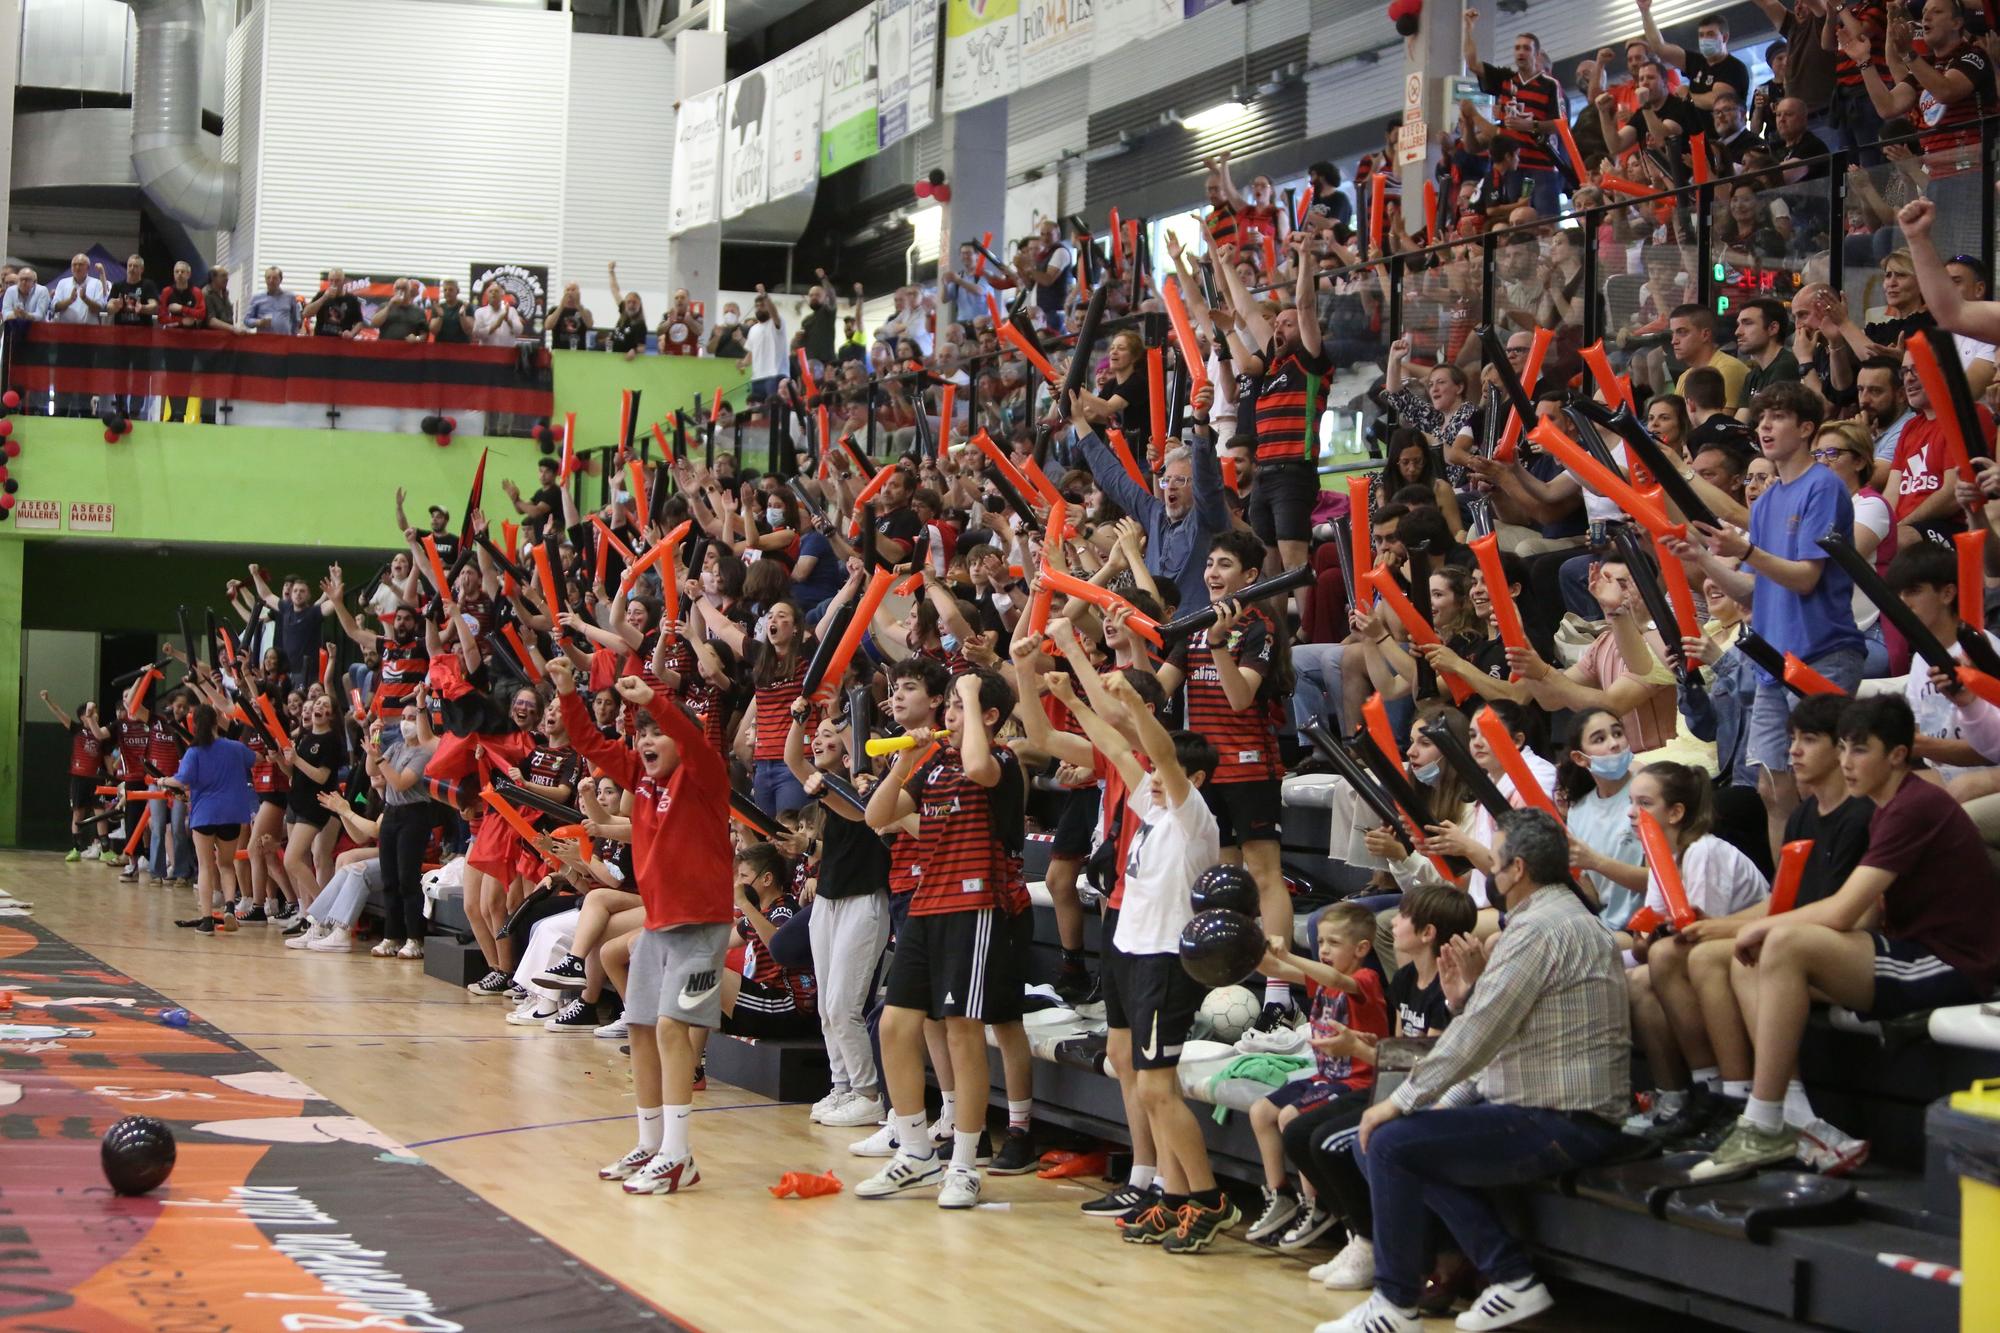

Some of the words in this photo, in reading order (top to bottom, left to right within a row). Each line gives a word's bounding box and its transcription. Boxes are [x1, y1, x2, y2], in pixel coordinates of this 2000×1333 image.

[21, 502, 56, 510] ASEOS
[71, 504, 112, 513] ASEOS
[17, 510, 59, 520] MULLERES
[71, 513, 111, 522] HOMES
[531, 751, 545, 766] 73
[686, 969, 716, 992] NIKE
